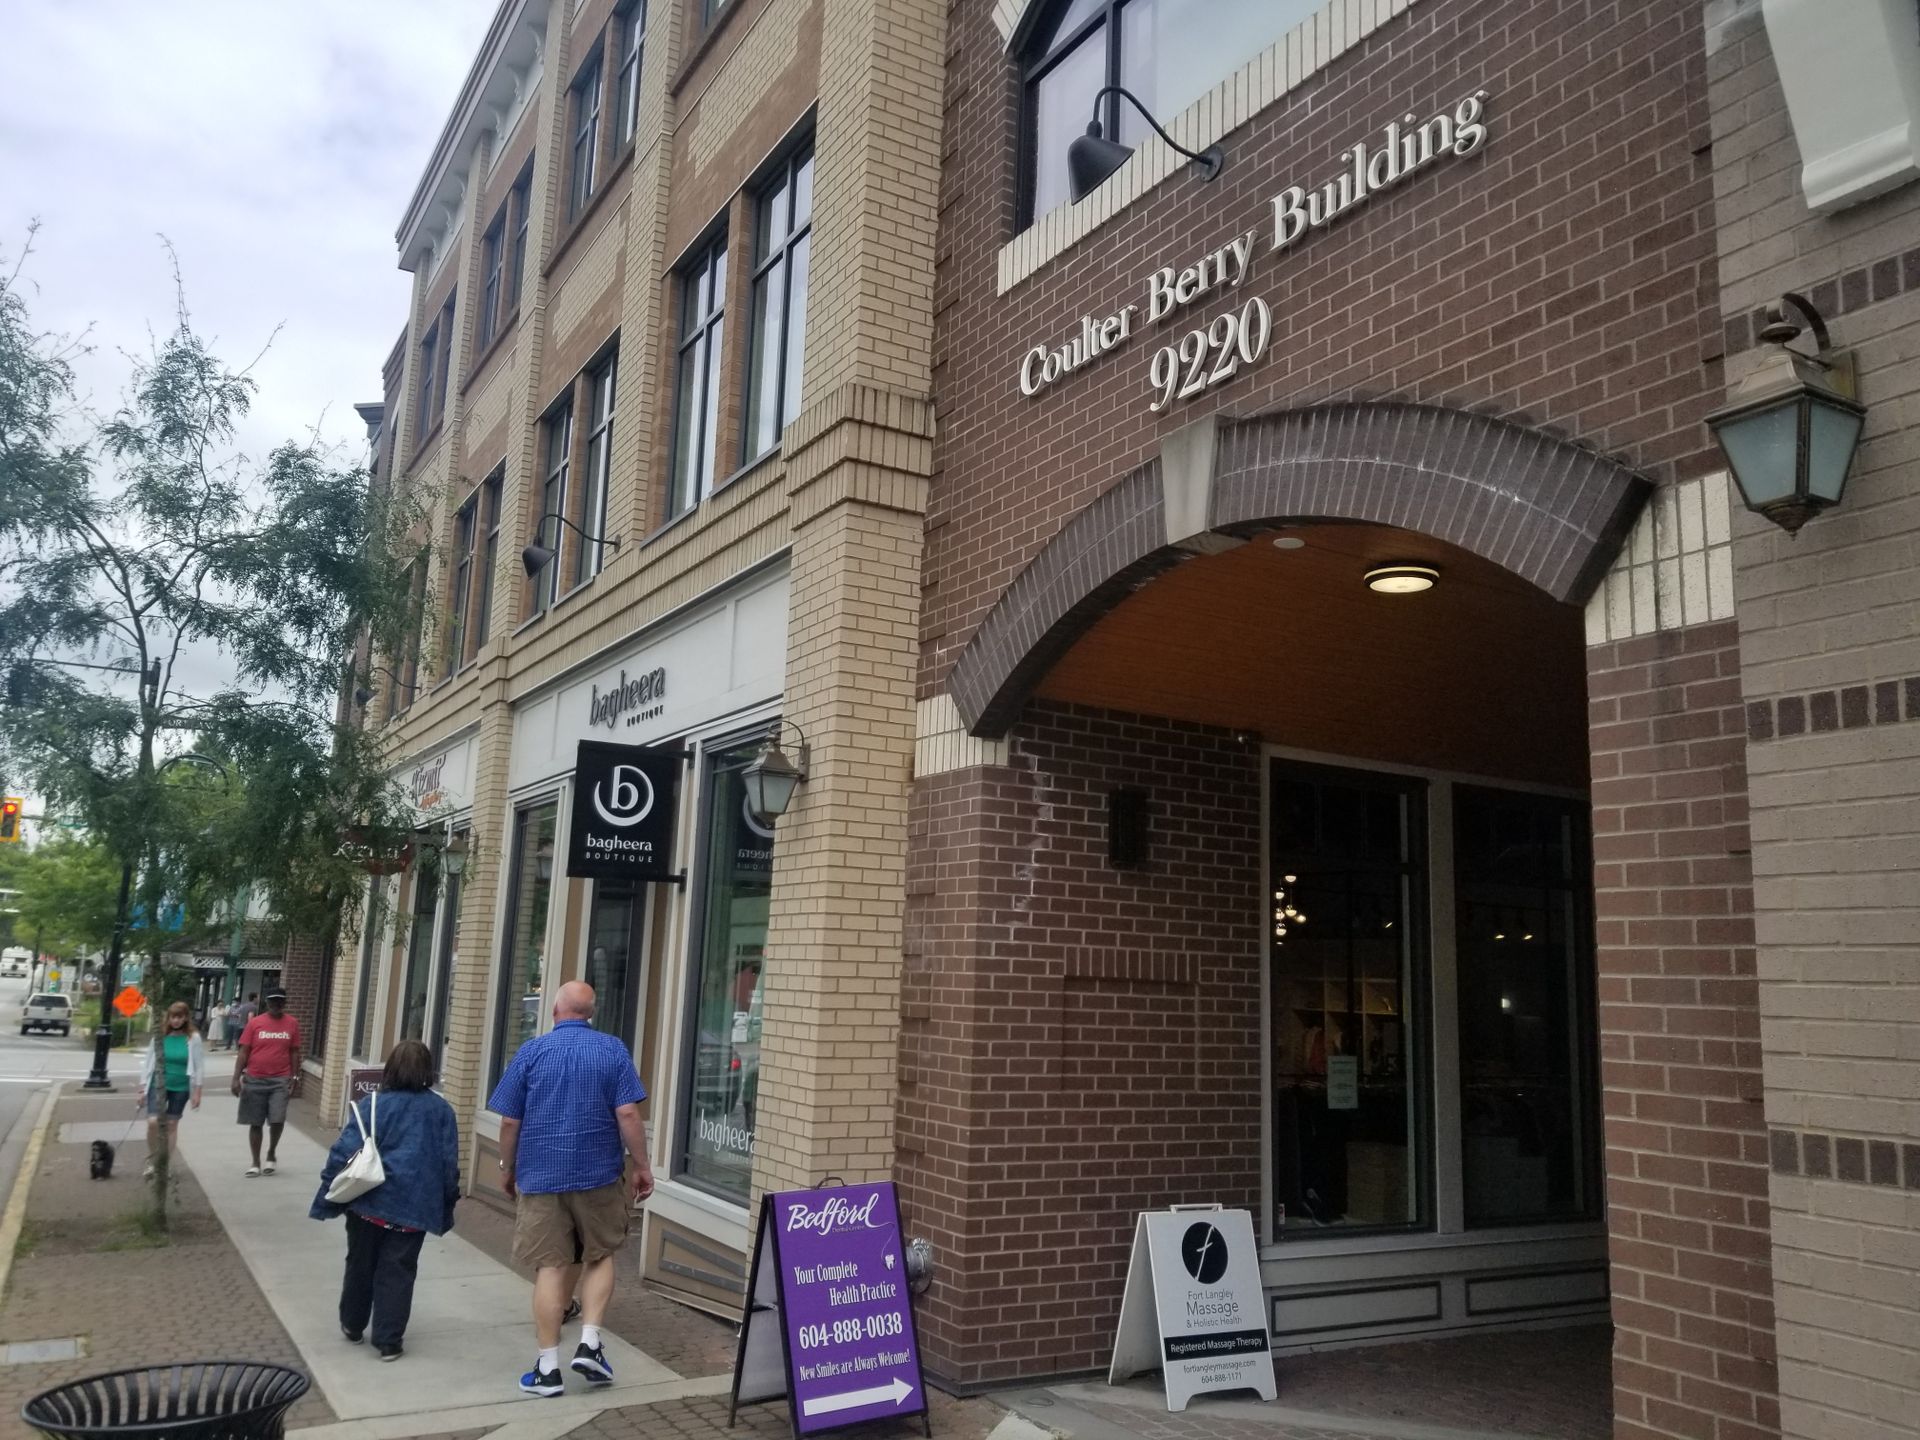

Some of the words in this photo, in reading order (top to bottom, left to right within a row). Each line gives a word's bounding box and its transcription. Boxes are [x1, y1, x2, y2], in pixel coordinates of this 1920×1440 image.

[1020, 304, 1138, 396] Coulter
[1146, 230, 1258, 324] Berry
[1269, 90, 1489, 251] Building
[1150, 296, 1272, 412] 9220
[589, 666, 666, 729] bagheera
[627, 704, 664, 727] BOUTIQUE
[586, 832, 653, 852] bagheera
[585, 851, 653, 863] BOUTIQUE
[787, 1193, 880, 1236] Bedford
[794, 1266, 815, 1286] Your
[817, 1260, 858, 1283] Complete
[829, 1285, 860, 1307] Health
[860, 1280, 897, 1302] Practice
[1188, 1290, 1204, 1301] Fort
[1205, 1288, 1234, 1301] Langley
[1186, 1300, 1240, 1317] Massage
[1193, 1318, 1219, 1328] Holistic
[1220, 1315, 1242, 1326] Health
[799, 1311, 903, 1350] 604-888-0038
[1170, 1341, 1206, 1354] Registered
[1207, 1340, 1236, 1350] Massage
[1236, 1337, 1263, 1347] Therapy
[800, 1365, 815, 1382] New
[816, 1361, 840, 1379] Smiles
[841, 1361, 852, 1374] are
[854, 1355, 878, 1372] Always
[878, 1347, 912, 1368] Welcome!
